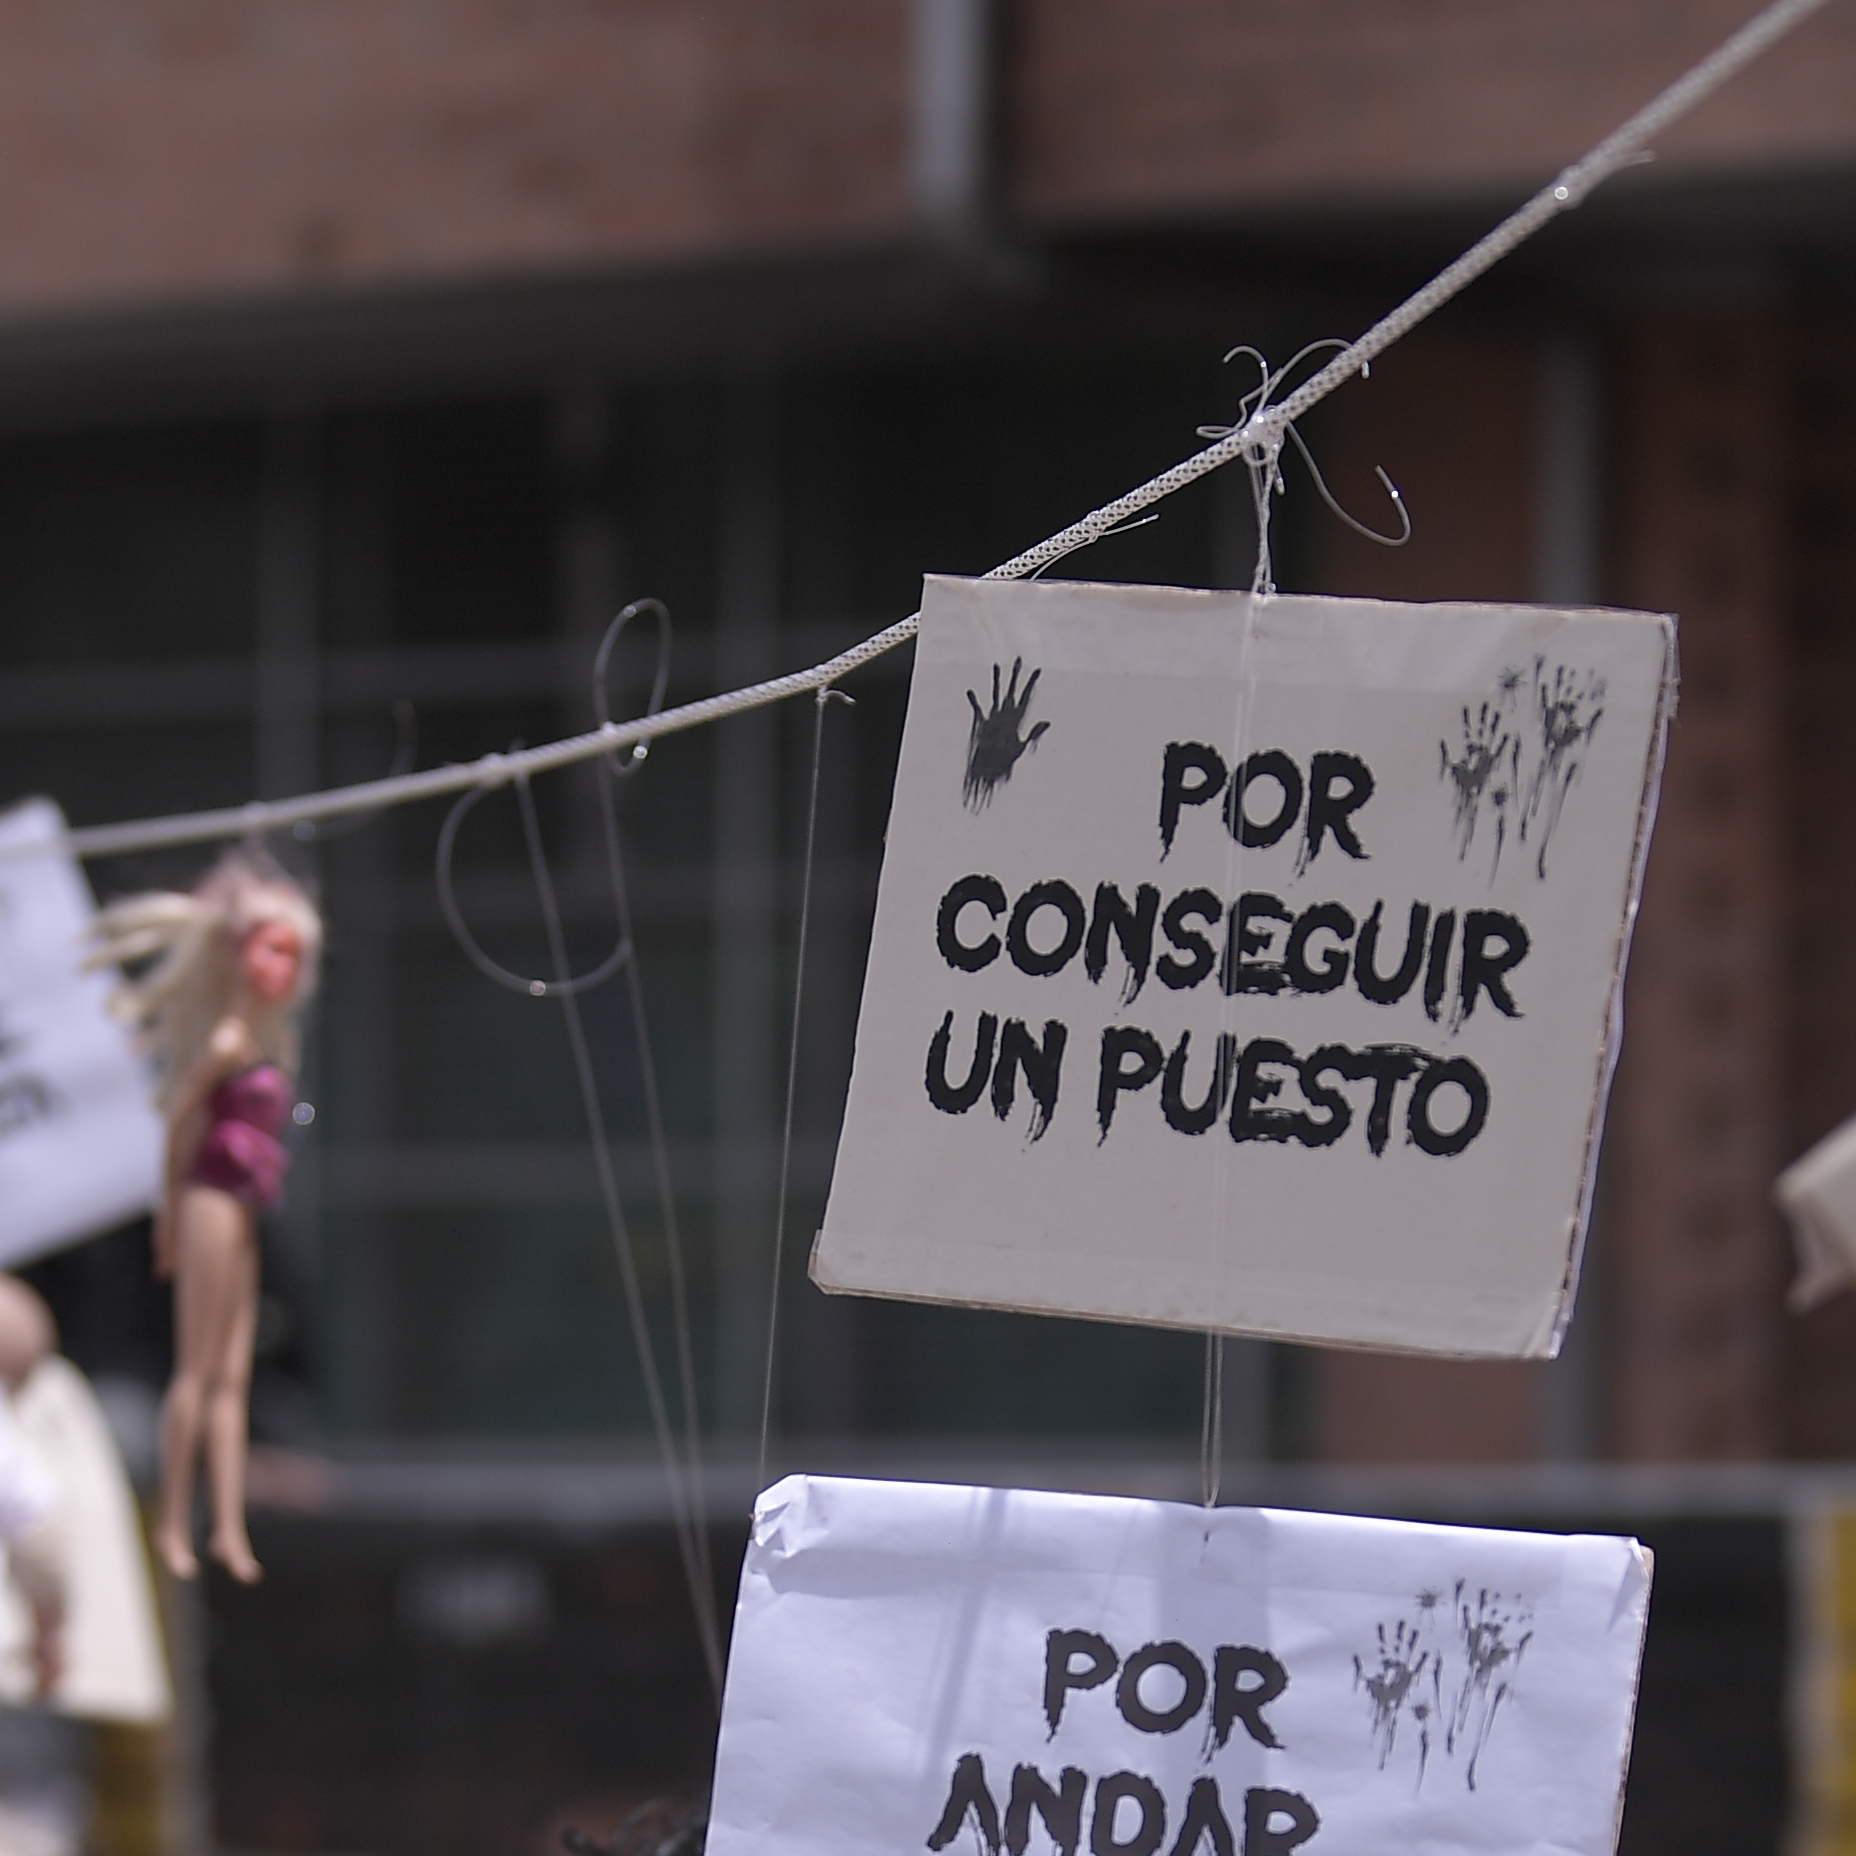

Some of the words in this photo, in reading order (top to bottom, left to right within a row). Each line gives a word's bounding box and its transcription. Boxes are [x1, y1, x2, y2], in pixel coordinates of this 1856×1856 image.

[1158, 741, 1375, 869] POR
[936, 874, 1531, 1030] CONSEGUIR
[925, 1010, 1067, 1146] UN
[1097, 1027, 1489, 1157] PUESTO
[1043, 1629, 1288, 1757] POR
